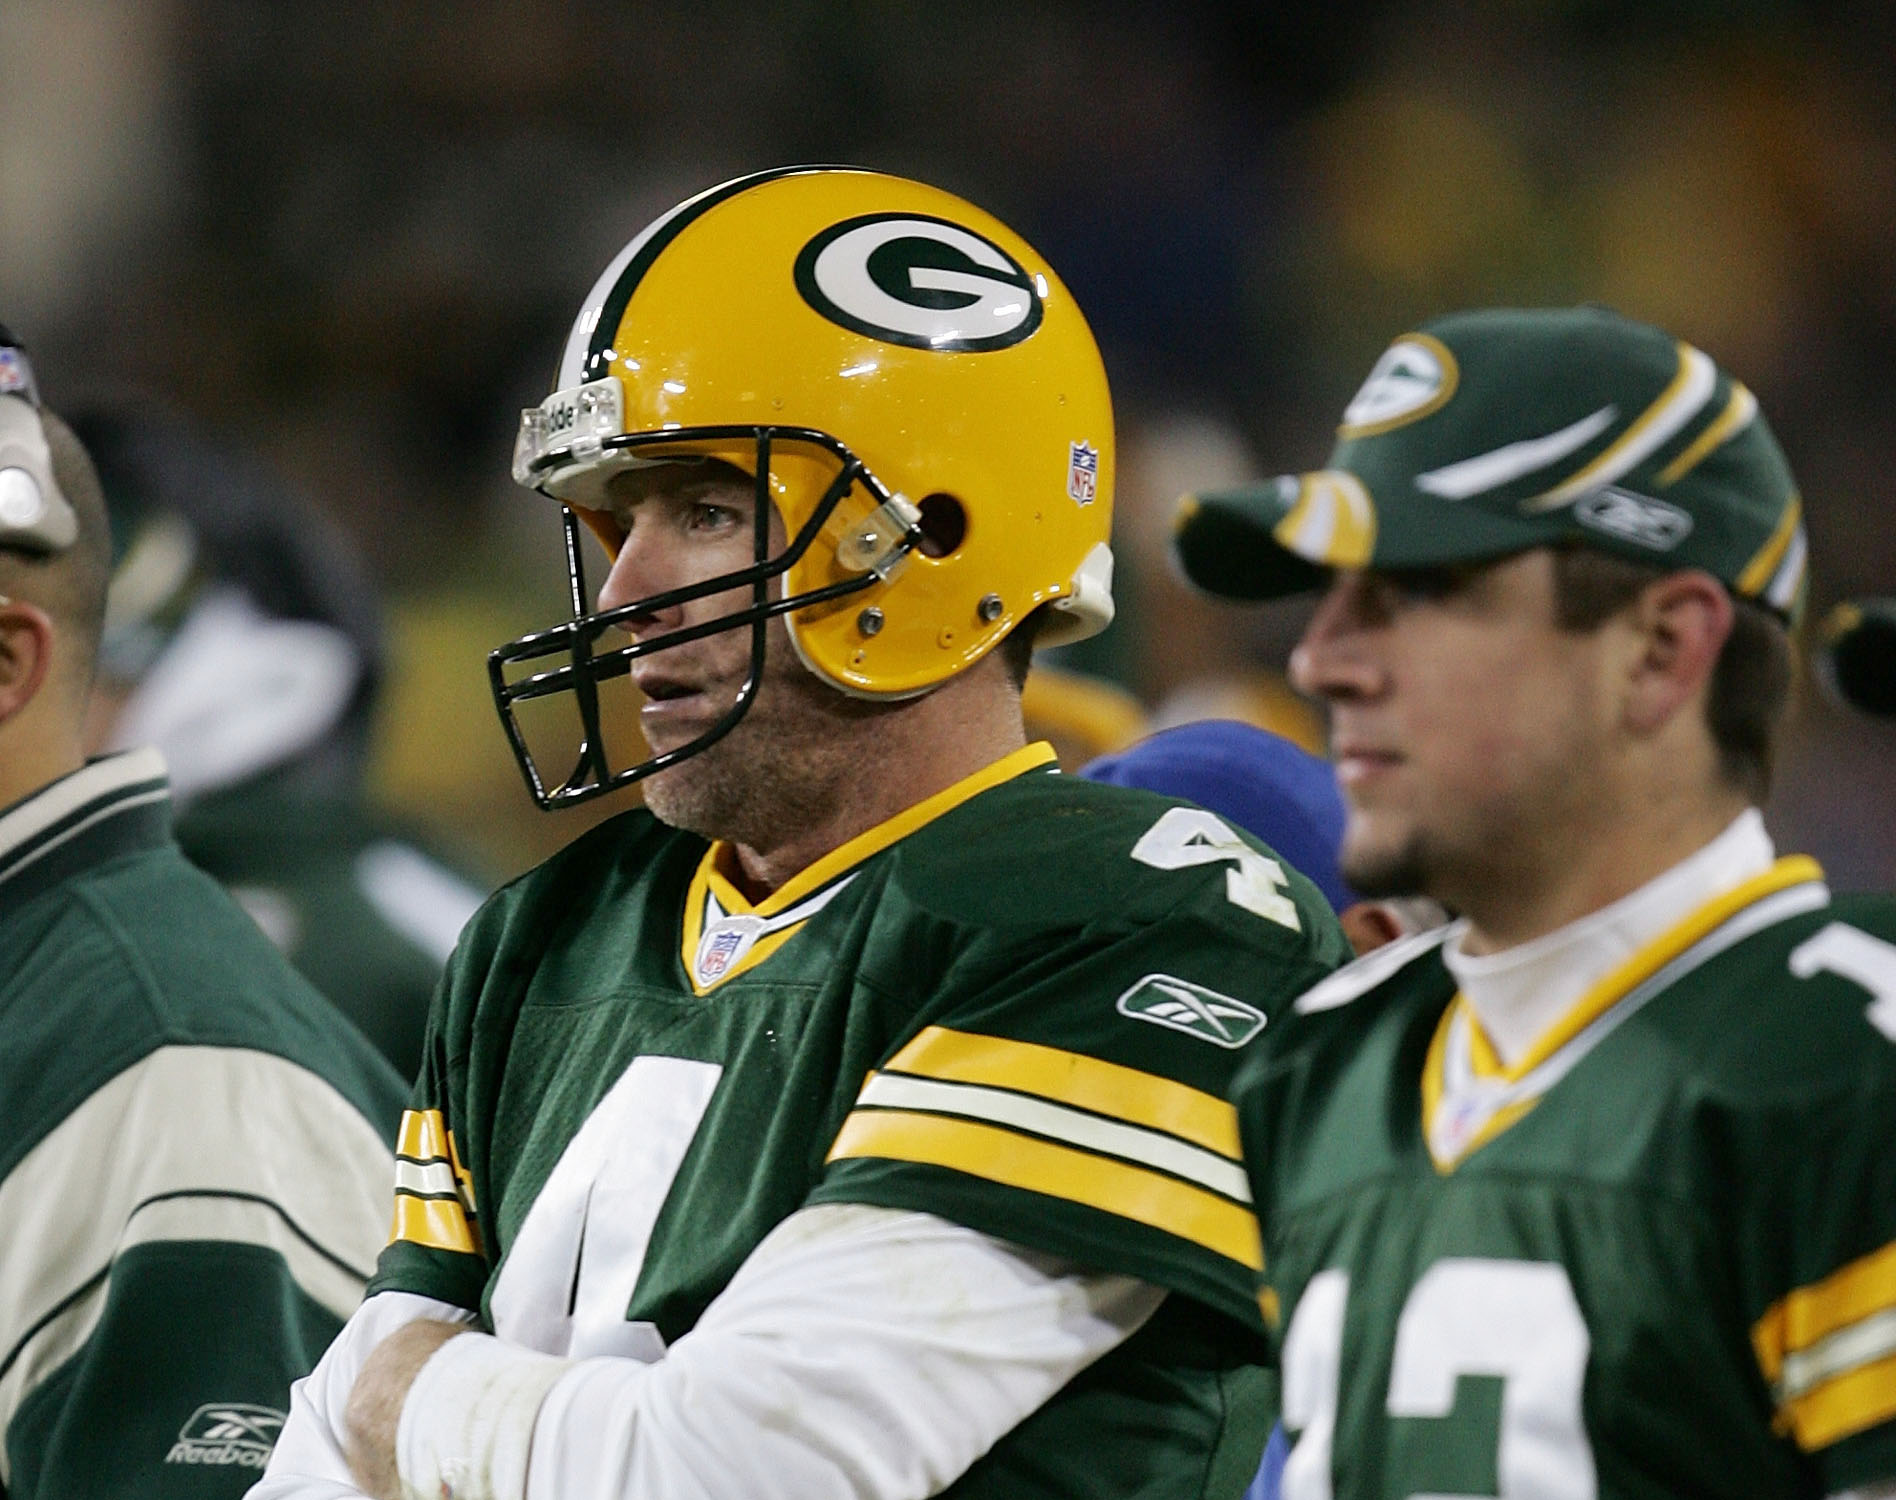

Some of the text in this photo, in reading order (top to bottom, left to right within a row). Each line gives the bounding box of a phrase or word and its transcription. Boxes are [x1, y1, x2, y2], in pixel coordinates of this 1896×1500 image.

[813, 219, 1032, 341] G
[1130, 806, 1301, 933] 4
[489, 1055, 724, 1364] 4
